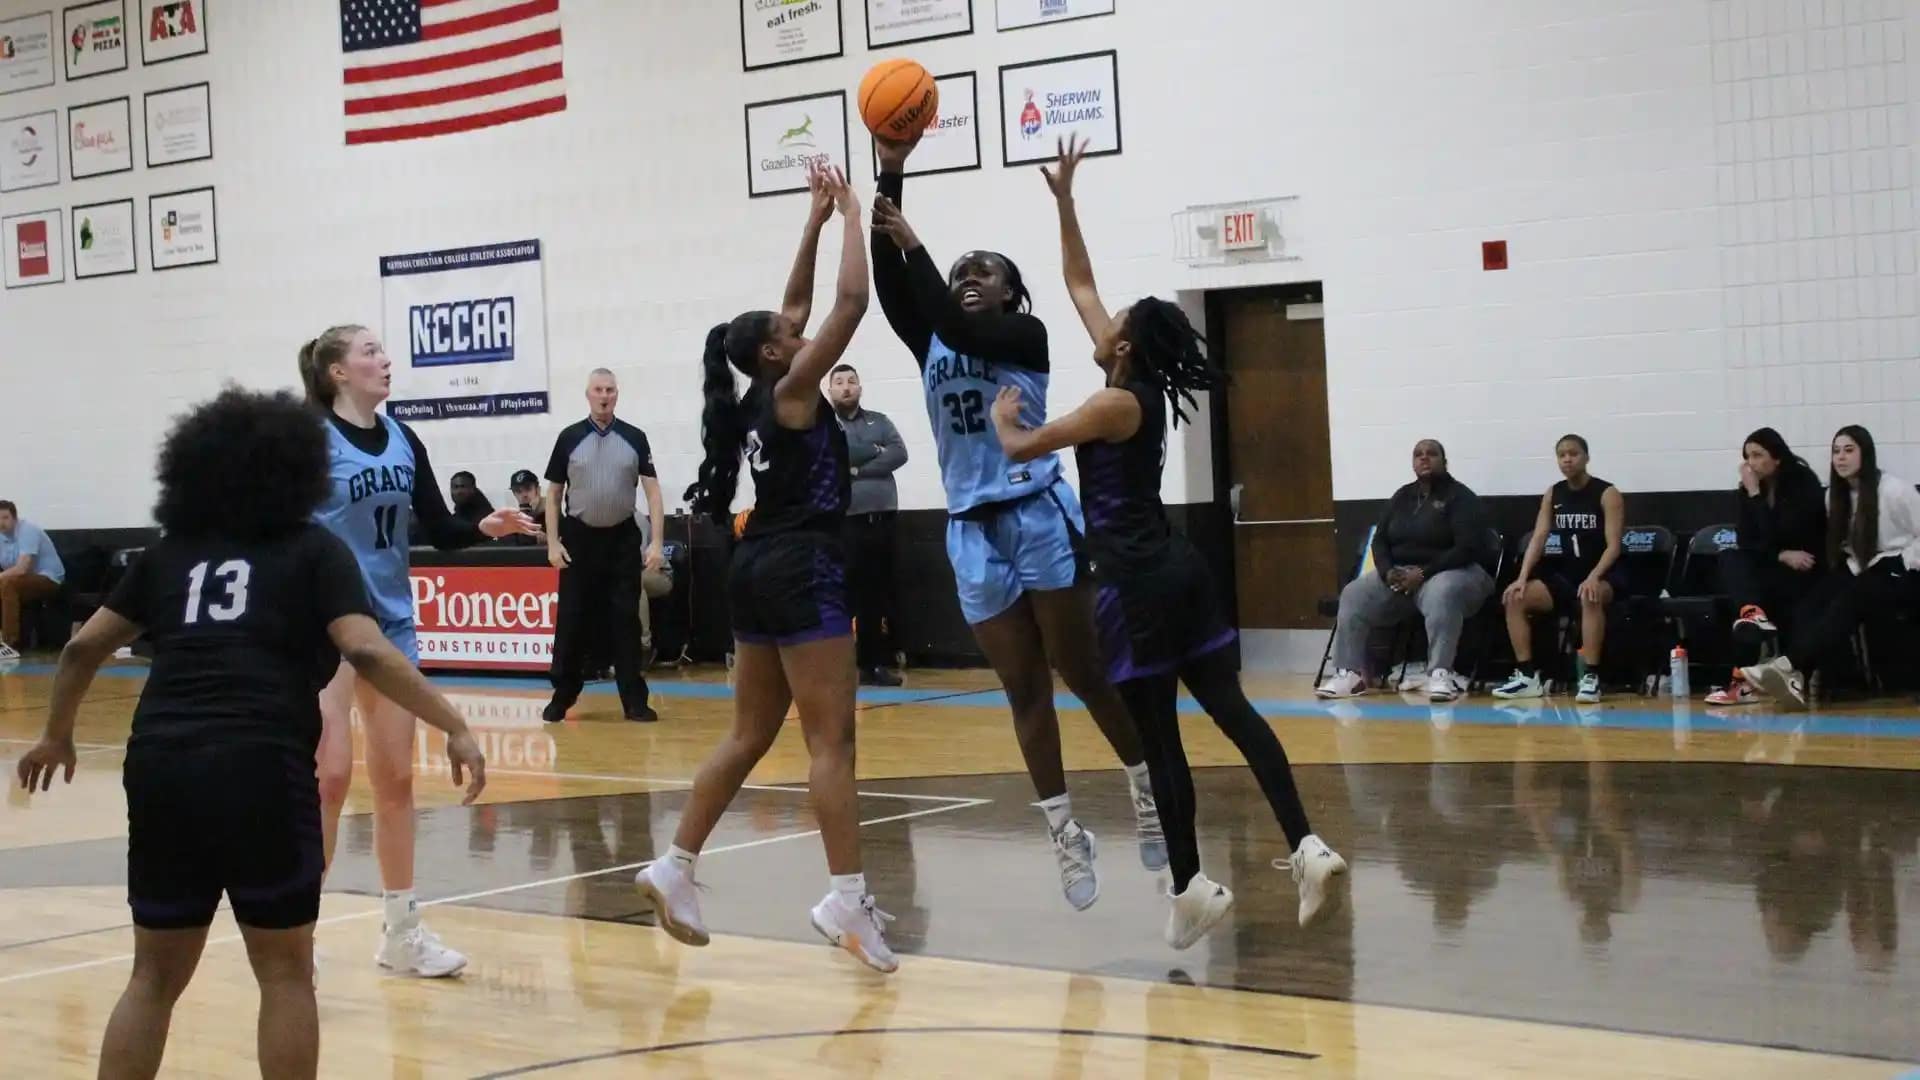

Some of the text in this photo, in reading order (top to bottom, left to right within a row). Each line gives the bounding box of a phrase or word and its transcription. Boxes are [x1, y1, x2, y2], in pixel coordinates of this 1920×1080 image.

[767, 13, 785, 28] eat
[789, 2, 822, 20] fresh.
[888, 89, 932, 132] Wilson
[1046, 90, 1100, 109] SHERWIN
[927, 114, 968, 130] Master
[761, 154, 796, 171] Gazelle
[1224, 213, 1254, 243] EXIT
[412, 256, 443, 268] CHRISTIAN
[443, 253, 469, 265] COLLEGE
[469, 249, 495, 262] ATHLETIC
[495, 245, 534, 258] ASSOCIATION
[410, 299, 514, 356] NCCAA
[929, 353, 998, 391] GRACE
[943, 389, 986, 435] 32
[374, 504, 398, 550] 11
[1571, 533, 1581, 558] 1
[184, 559, 251, 625] 13
[409, 575, 559, 629] Pioneer
[417, 639, 554, 656] CONSTRUCTION
